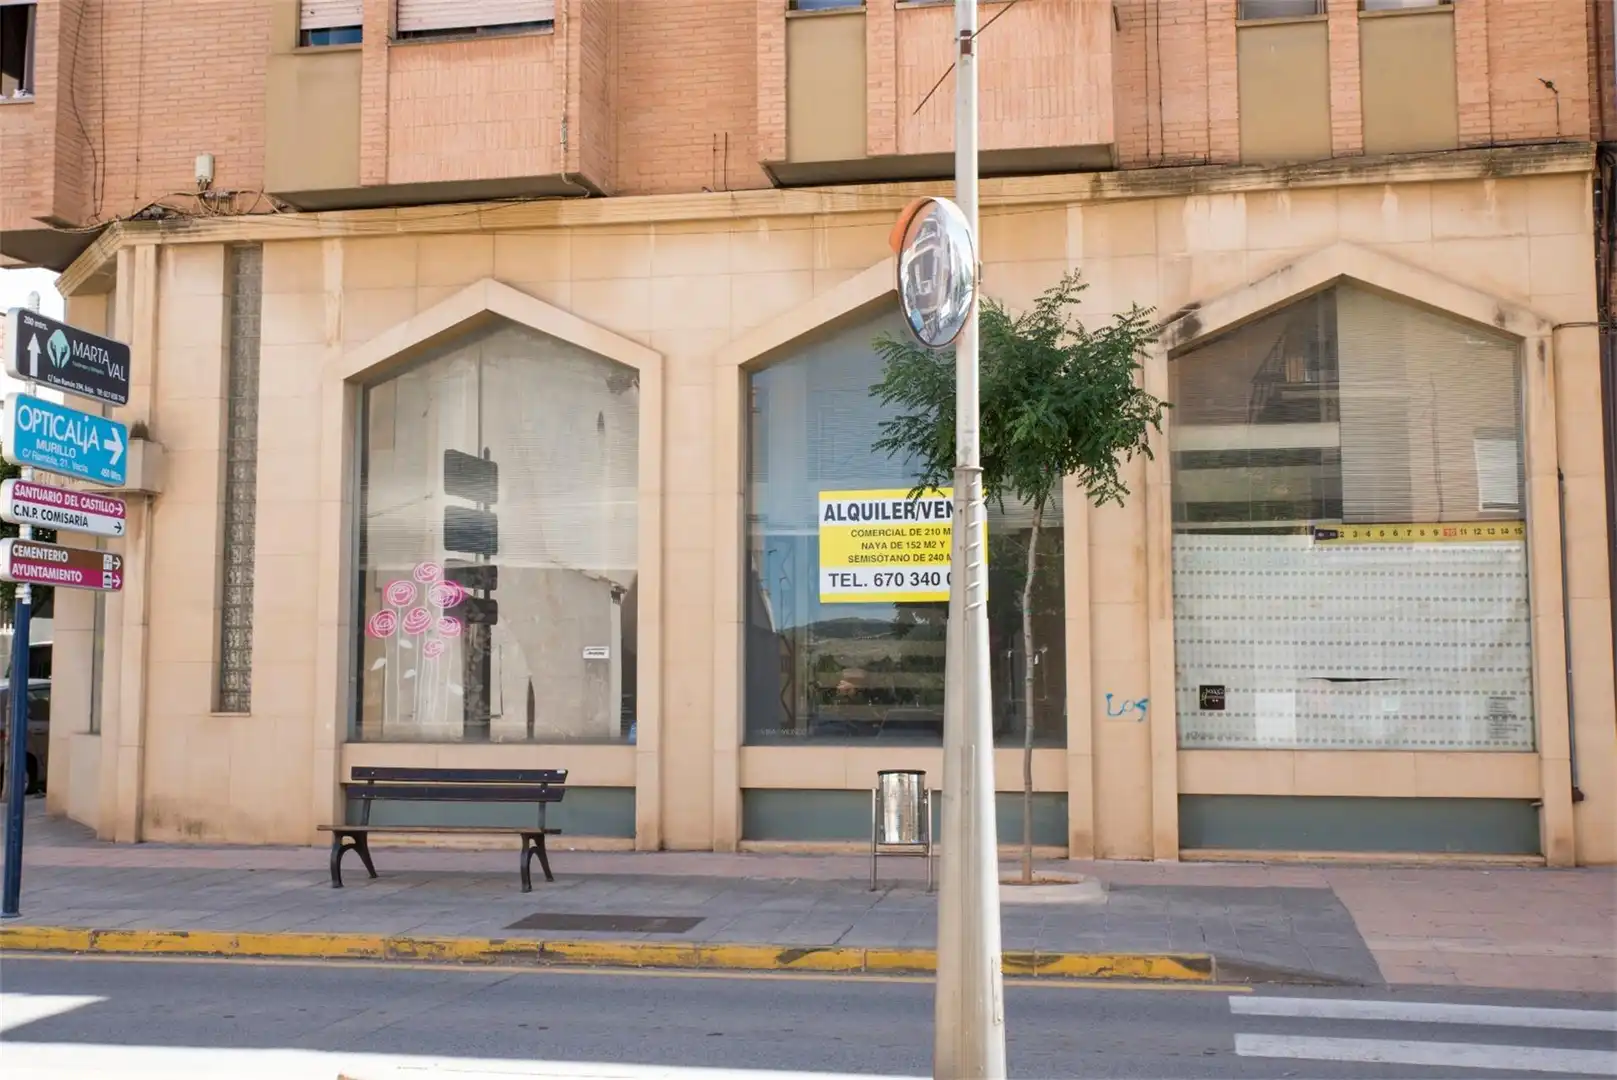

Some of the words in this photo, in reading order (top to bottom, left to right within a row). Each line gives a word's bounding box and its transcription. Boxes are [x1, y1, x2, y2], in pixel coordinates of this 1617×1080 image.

[72, 340, 109, 364] MARTA
[106, 363, 126, 382] VAL
[22, 448, 31, 458] C/
[36, 439, 76, 459] MURILLO
[14, 484, 62, 503] SANTUARIO
[64, 494, 79, 507] DEL
[80, 496, 115, 513] CASTILLO
[13, 504, 39, 520] C.N.P.
[850, 529, 907, 537] COMERCIAL
[909, 528, 922, 536] DE
[924, 527, 941, 536] 210
[1352, 530, 1358, 538] 3
[1365, 529, 1371, 537] 4
[1379, 529, 1385, 537] 5
[1392, 529, 1398, 537] 6
[1406, 529, 1412, 537] 7
[1419, 529, 1425, 537] 8
[1433, 528, 1439, 537] 9
[1473, 527, 1482, 535] 12
[1487, 527, 1496, 535] 13
[1500, 527, 1509, 535] 14
[1514, 527, 1523, 535] 15
[12, 544, 69, 563] CEMENTERIO
[861, 542, 887, 550] NAYA
[890, 541, 903, 549] DE
[906, 540, 921, 549] 152
[924, 540, 937, 549] M2
[939, 540, 946, 548] Y
[913, 553, 926, 562] DE
[928, 553, 944, 562] 240
[11, 563, 83, 583] AYUNTAMIENTO
[828, 572, 868, 588] TEL.
[873, 572, 905, 588] 670
[909, 571, 941, 587] 340
